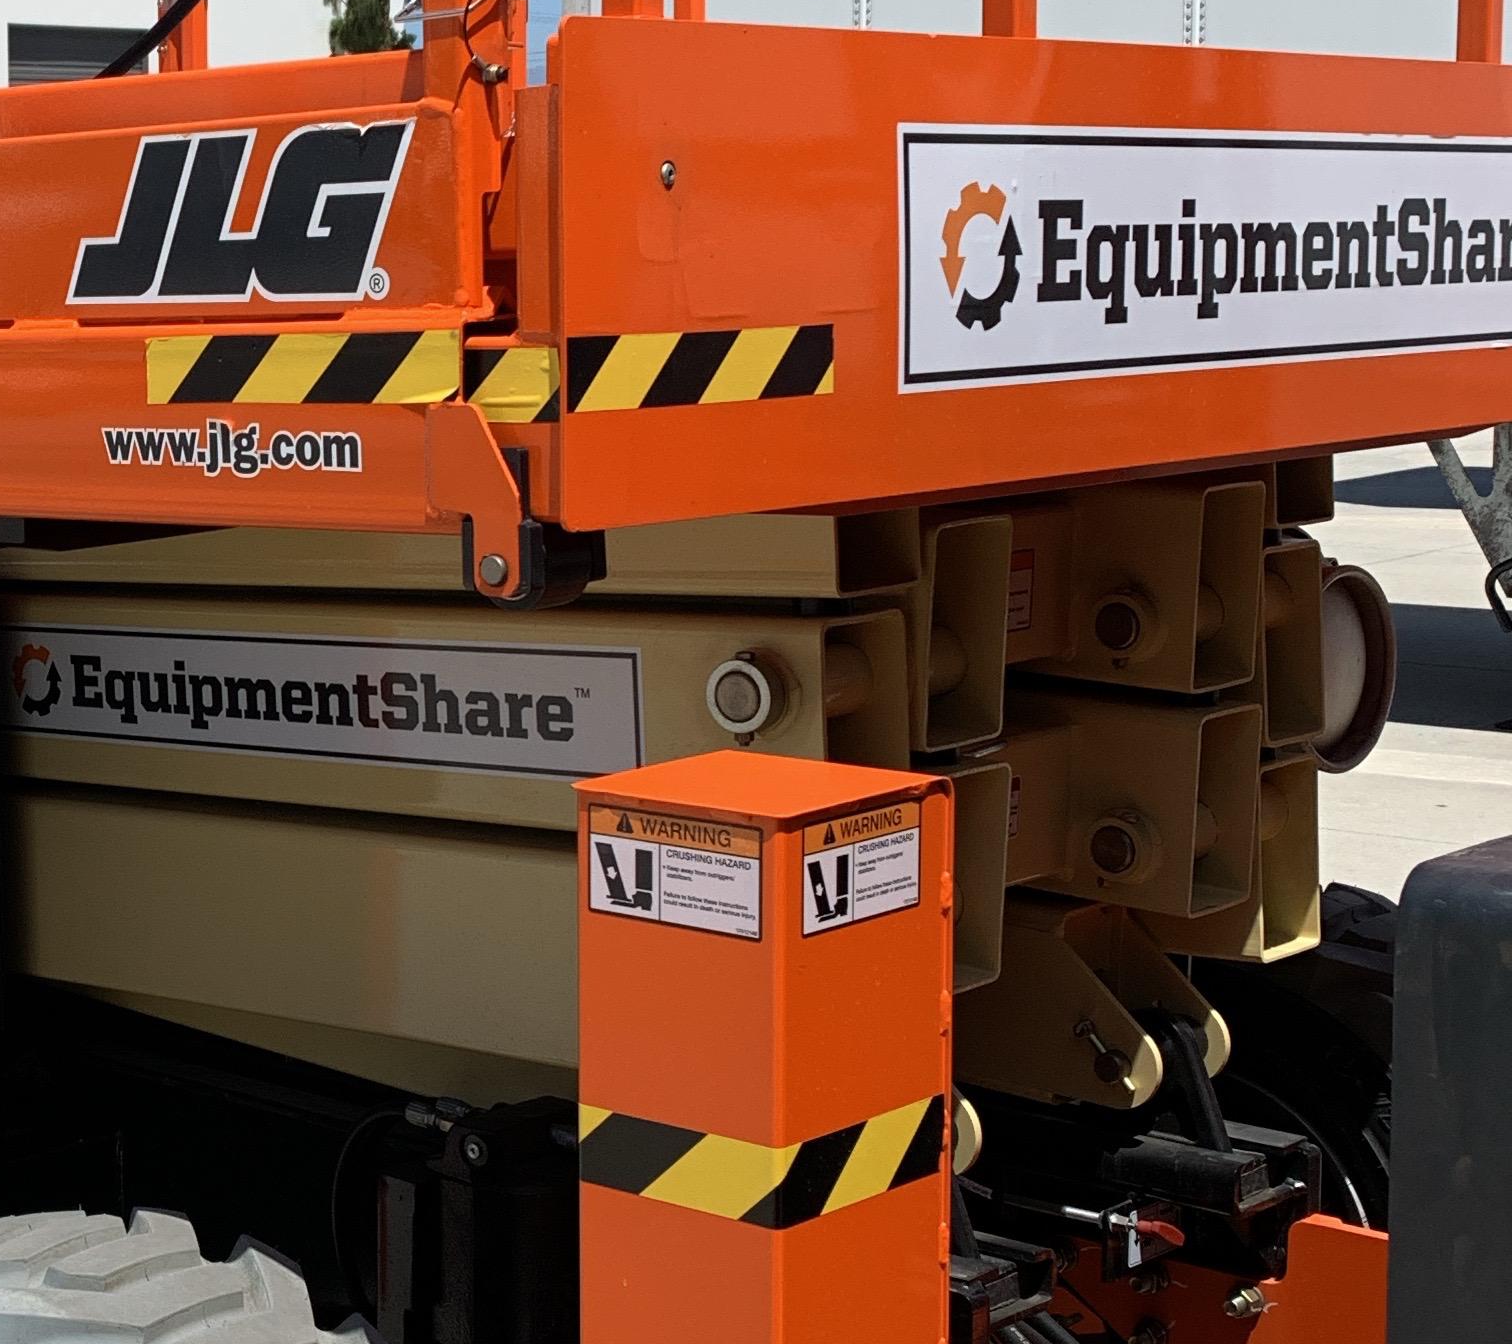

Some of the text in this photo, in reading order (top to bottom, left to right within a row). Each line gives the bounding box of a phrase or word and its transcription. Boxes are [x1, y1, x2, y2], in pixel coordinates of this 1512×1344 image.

[66, 118, 417, 304] JLG
[103, 419, 361, 476] www.jlg.com
[70, 654, 574, 742] EquipmentShare
[640, 817, 731, 848] WARNING
[839, 808, 902, 839] WARNING
[666, 848, 752, 871] CRUSHING HAZARD
